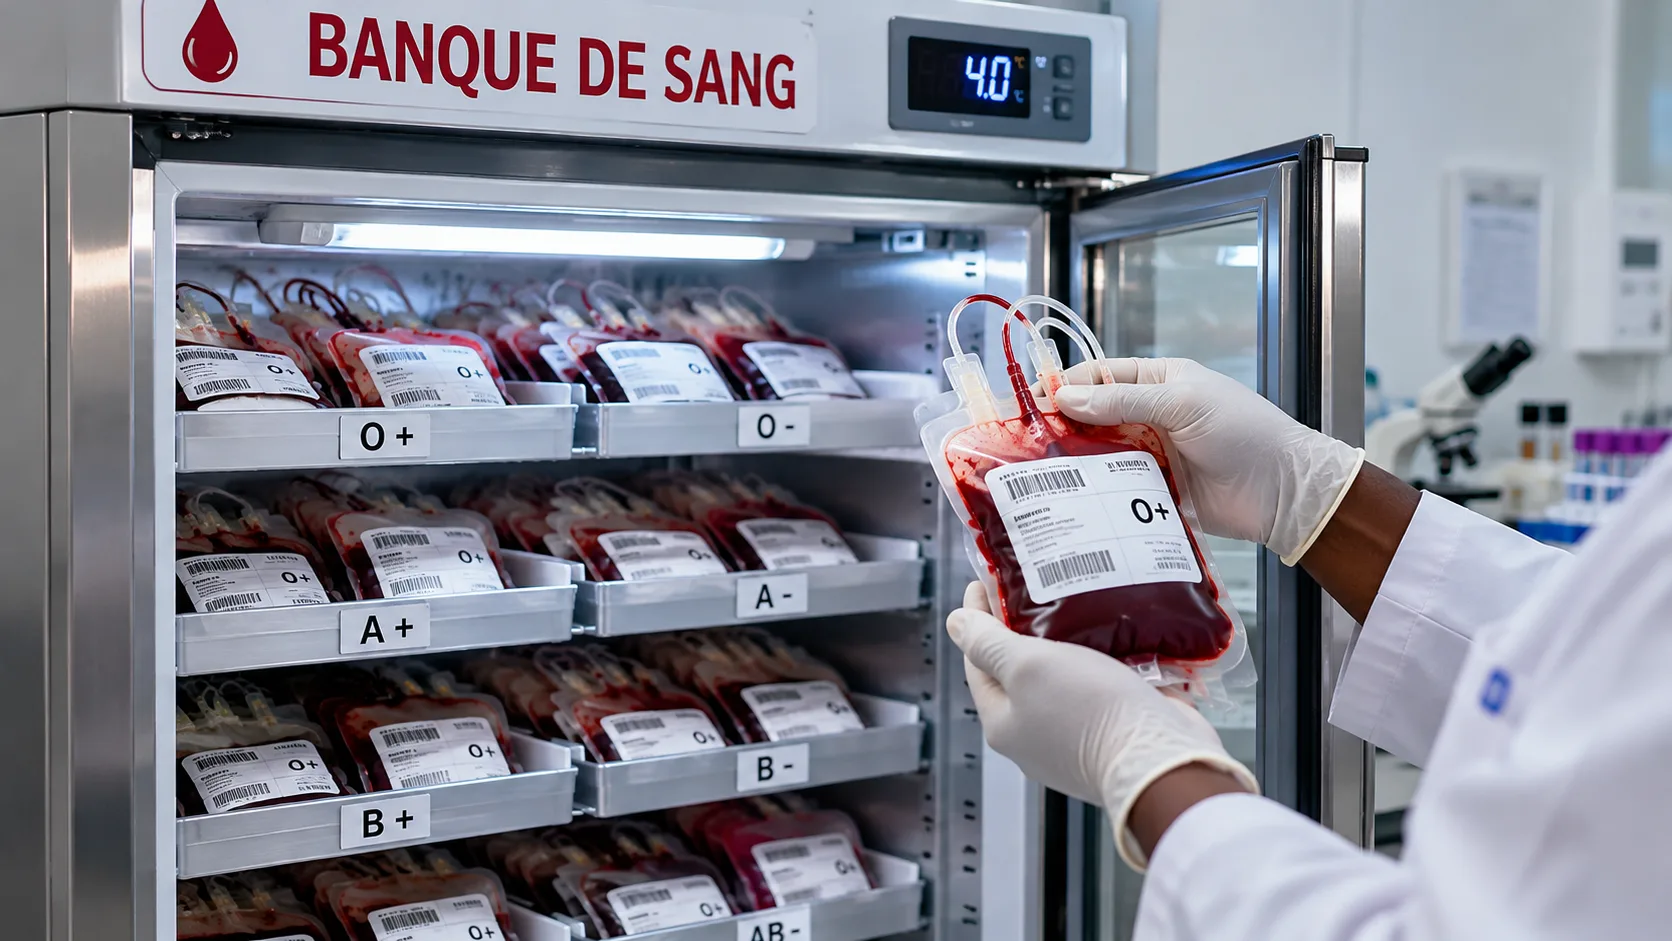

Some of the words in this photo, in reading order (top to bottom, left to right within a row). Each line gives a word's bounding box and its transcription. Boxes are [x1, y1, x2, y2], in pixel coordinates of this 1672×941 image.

[308, 11, 557, 99] BANQUE
[578, 37, 647, 100] DE
[663, 45, 797, 110] SANG
[965, 56, 1012, 102] 4.0
[457, 366, 484, 380] O+
[1130, 498, 1170, 524] O+
[458, 550, 484, 564] O+
[280, 571, 312, 584] O+
[755, 584, 774, 609] A
[360, 615, 385, 645] A
[467, 743, 496, 758] O+
[288, 758, 319, 772] O+
[757, 756, 774, 781] B
[362, 808, 384, 839] B
[468, 925, 496, 941] O+
[751, 922, 785, 941] AB
